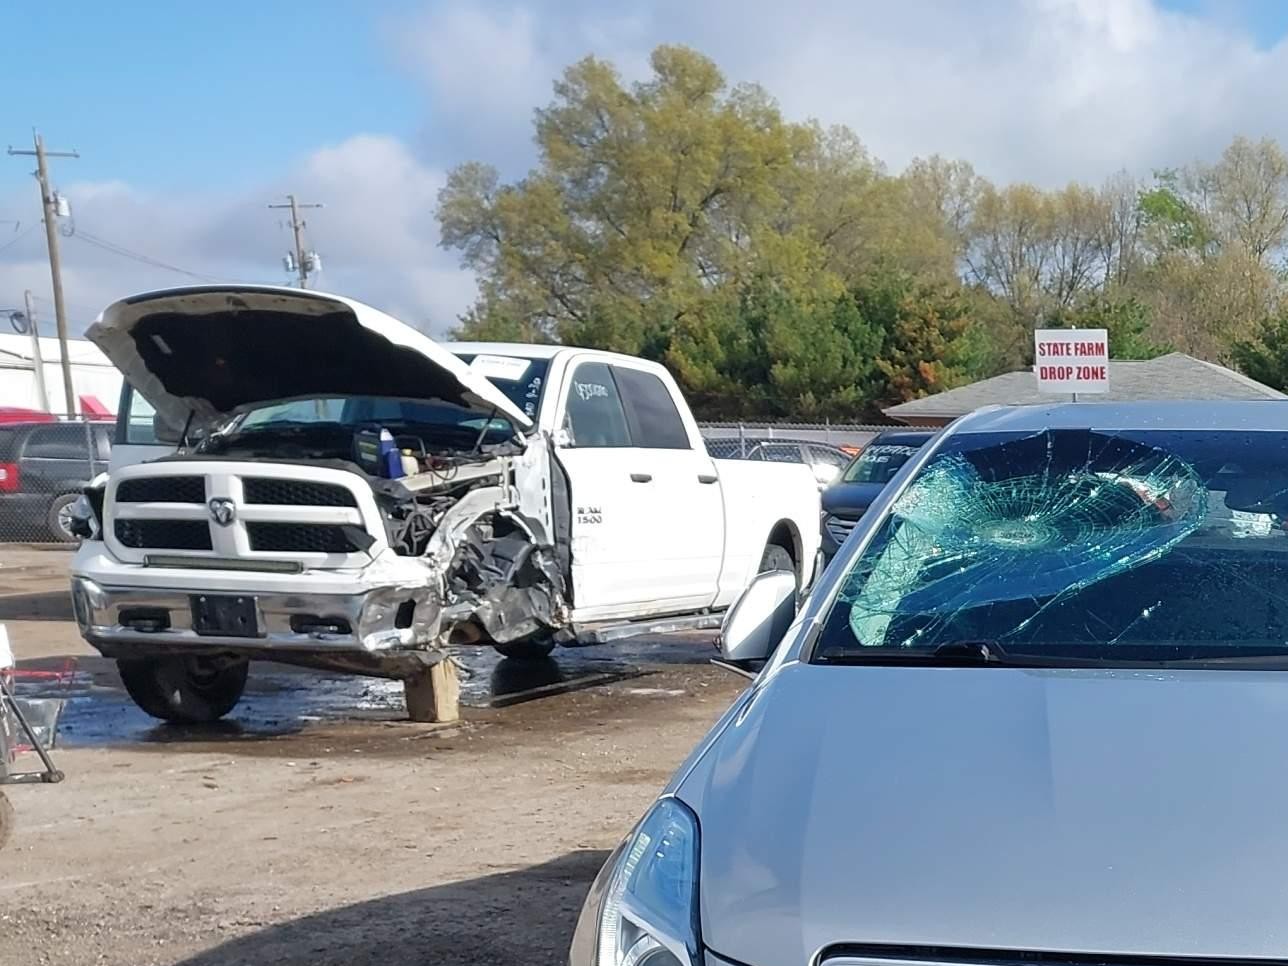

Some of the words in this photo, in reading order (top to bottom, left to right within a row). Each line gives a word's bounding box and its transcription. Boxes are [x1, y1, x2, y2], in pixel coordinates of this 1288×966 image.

[1039, 342, 1072, 356] STATE
[1074, 342, 1105, 356] FARM
[1040, 366, 1073, 380] DROP
[1075, 366, 1106, 380] ZONE
[577, 506, 602, 515] RAM
[578, 515, 602, 524] 1500
